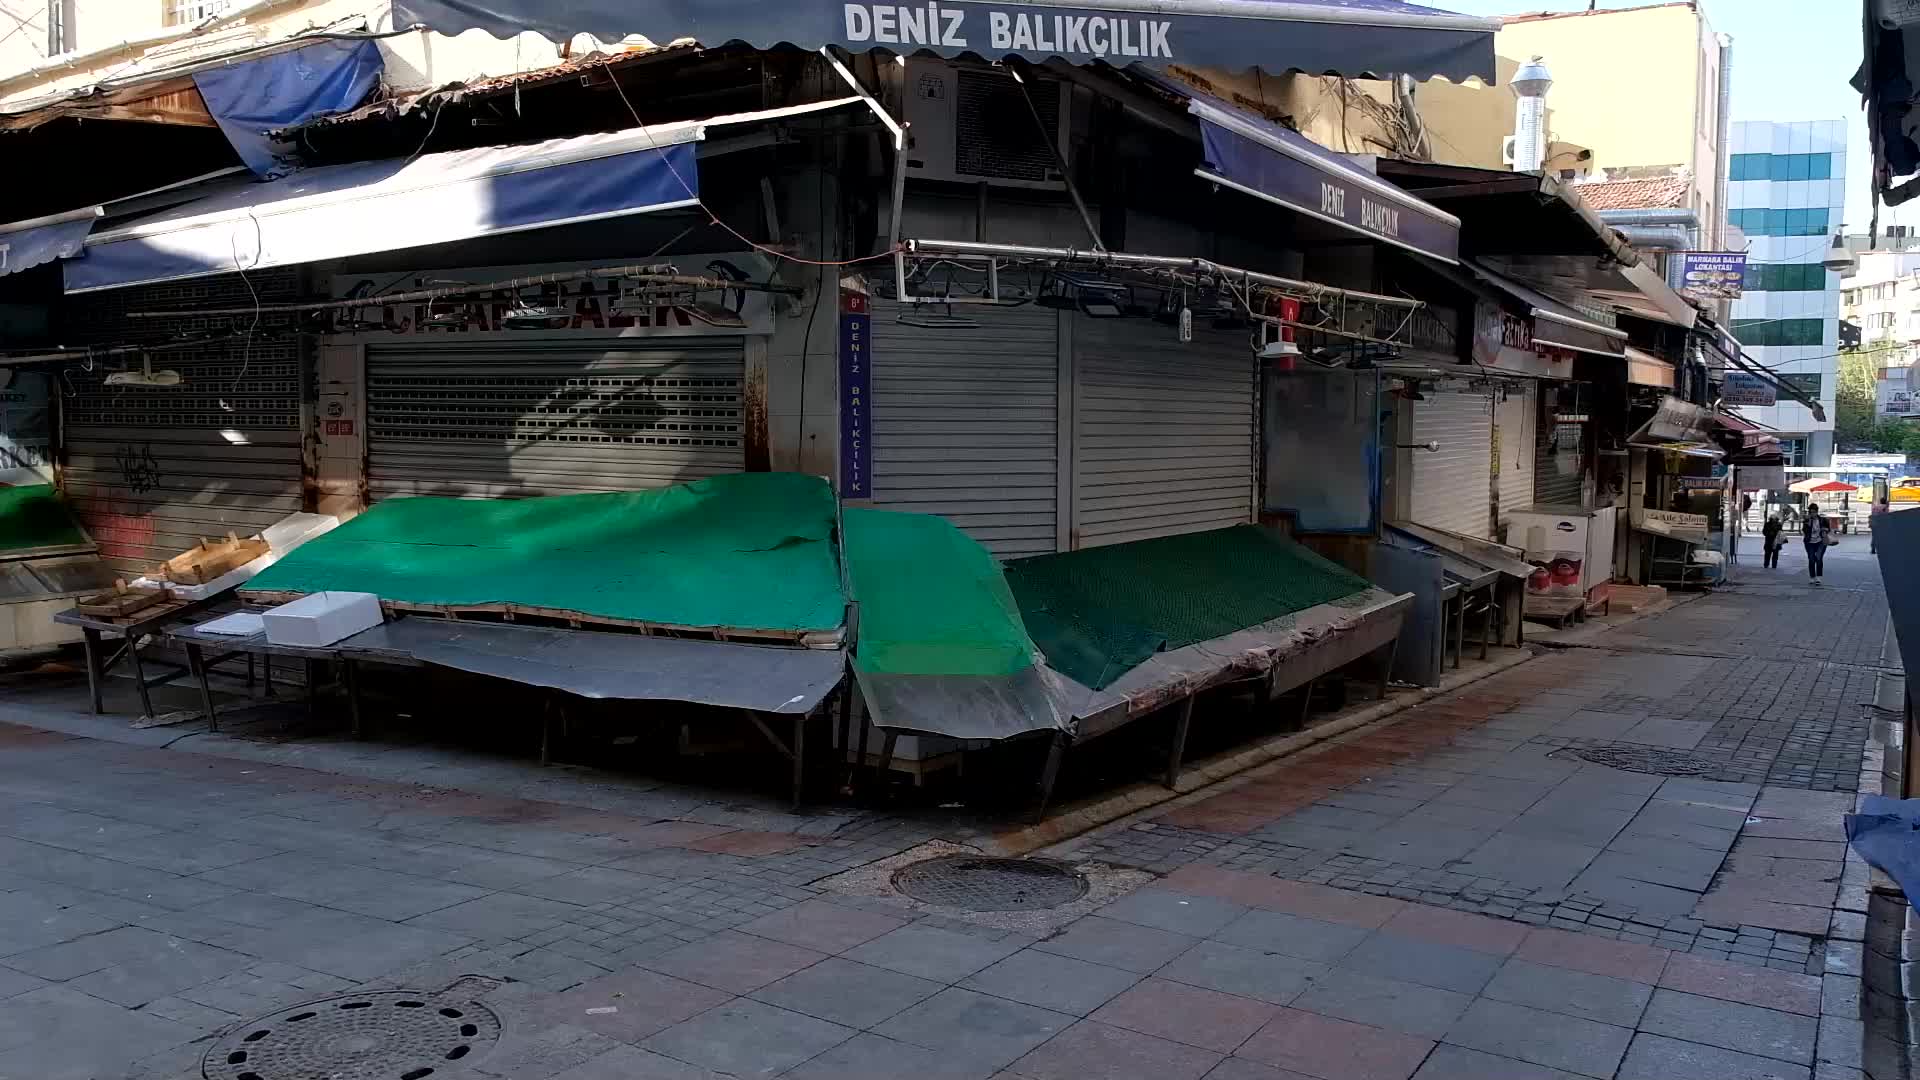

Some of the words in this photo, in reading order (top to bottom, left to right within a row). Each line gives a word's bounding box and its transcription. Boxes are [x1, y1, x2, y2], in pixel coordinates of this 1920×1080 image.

[844, 1, 968, 48] DENİZ
[990, 11, 1174, 58] BALIKÇILIK
[1321, 182, 1345, 218] DENİZ
[1361, 198, 1400, 237] BALIKÇILIK
[1687, 255, 1722, 264] MARMARA
[1722, 256, 1745, 264] BALIK
[851, 322, 861, 374] DENİZ
